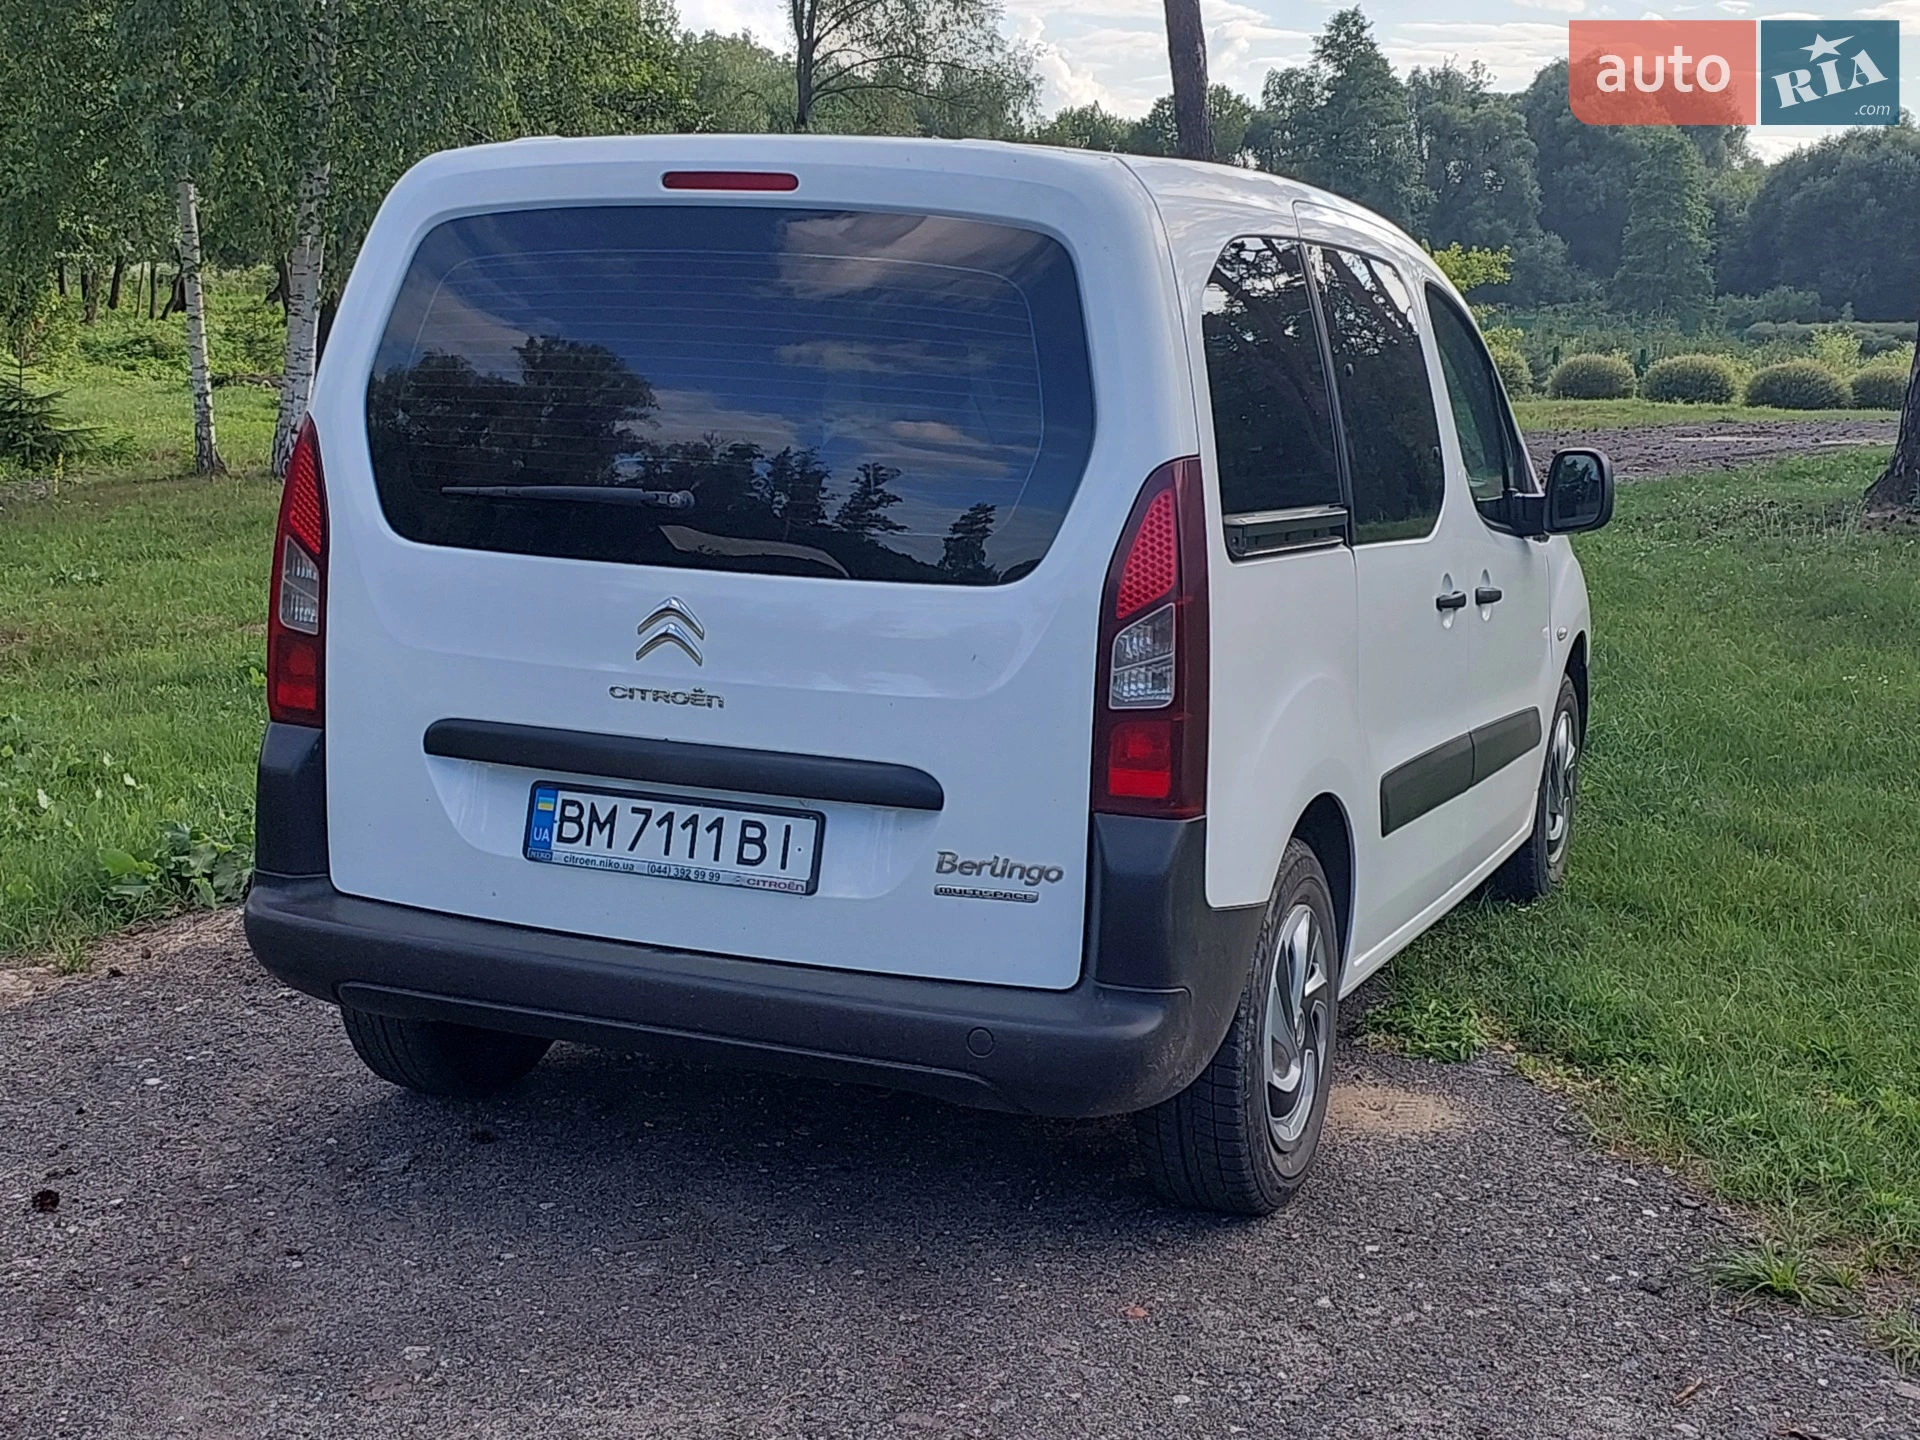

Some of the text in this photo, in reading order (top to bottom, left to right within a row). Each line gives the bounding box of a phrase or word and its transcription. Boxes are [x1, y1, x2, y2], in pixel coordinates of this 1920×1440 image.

[533, 826, 550, 843] UA
[627, 807, 725, 863] 7111
[563, 853, 635, 872] citroen.niko.ua
[647, 862, 672, 876] (044)
[673, 865, 691, 879] 392
[694, 869, 706, 881] 99
[709, 871, 721, 883] 99
[935, 851, 1064, 887] Berlingo
[937, 887, 1036, 901] MULTISPACE
